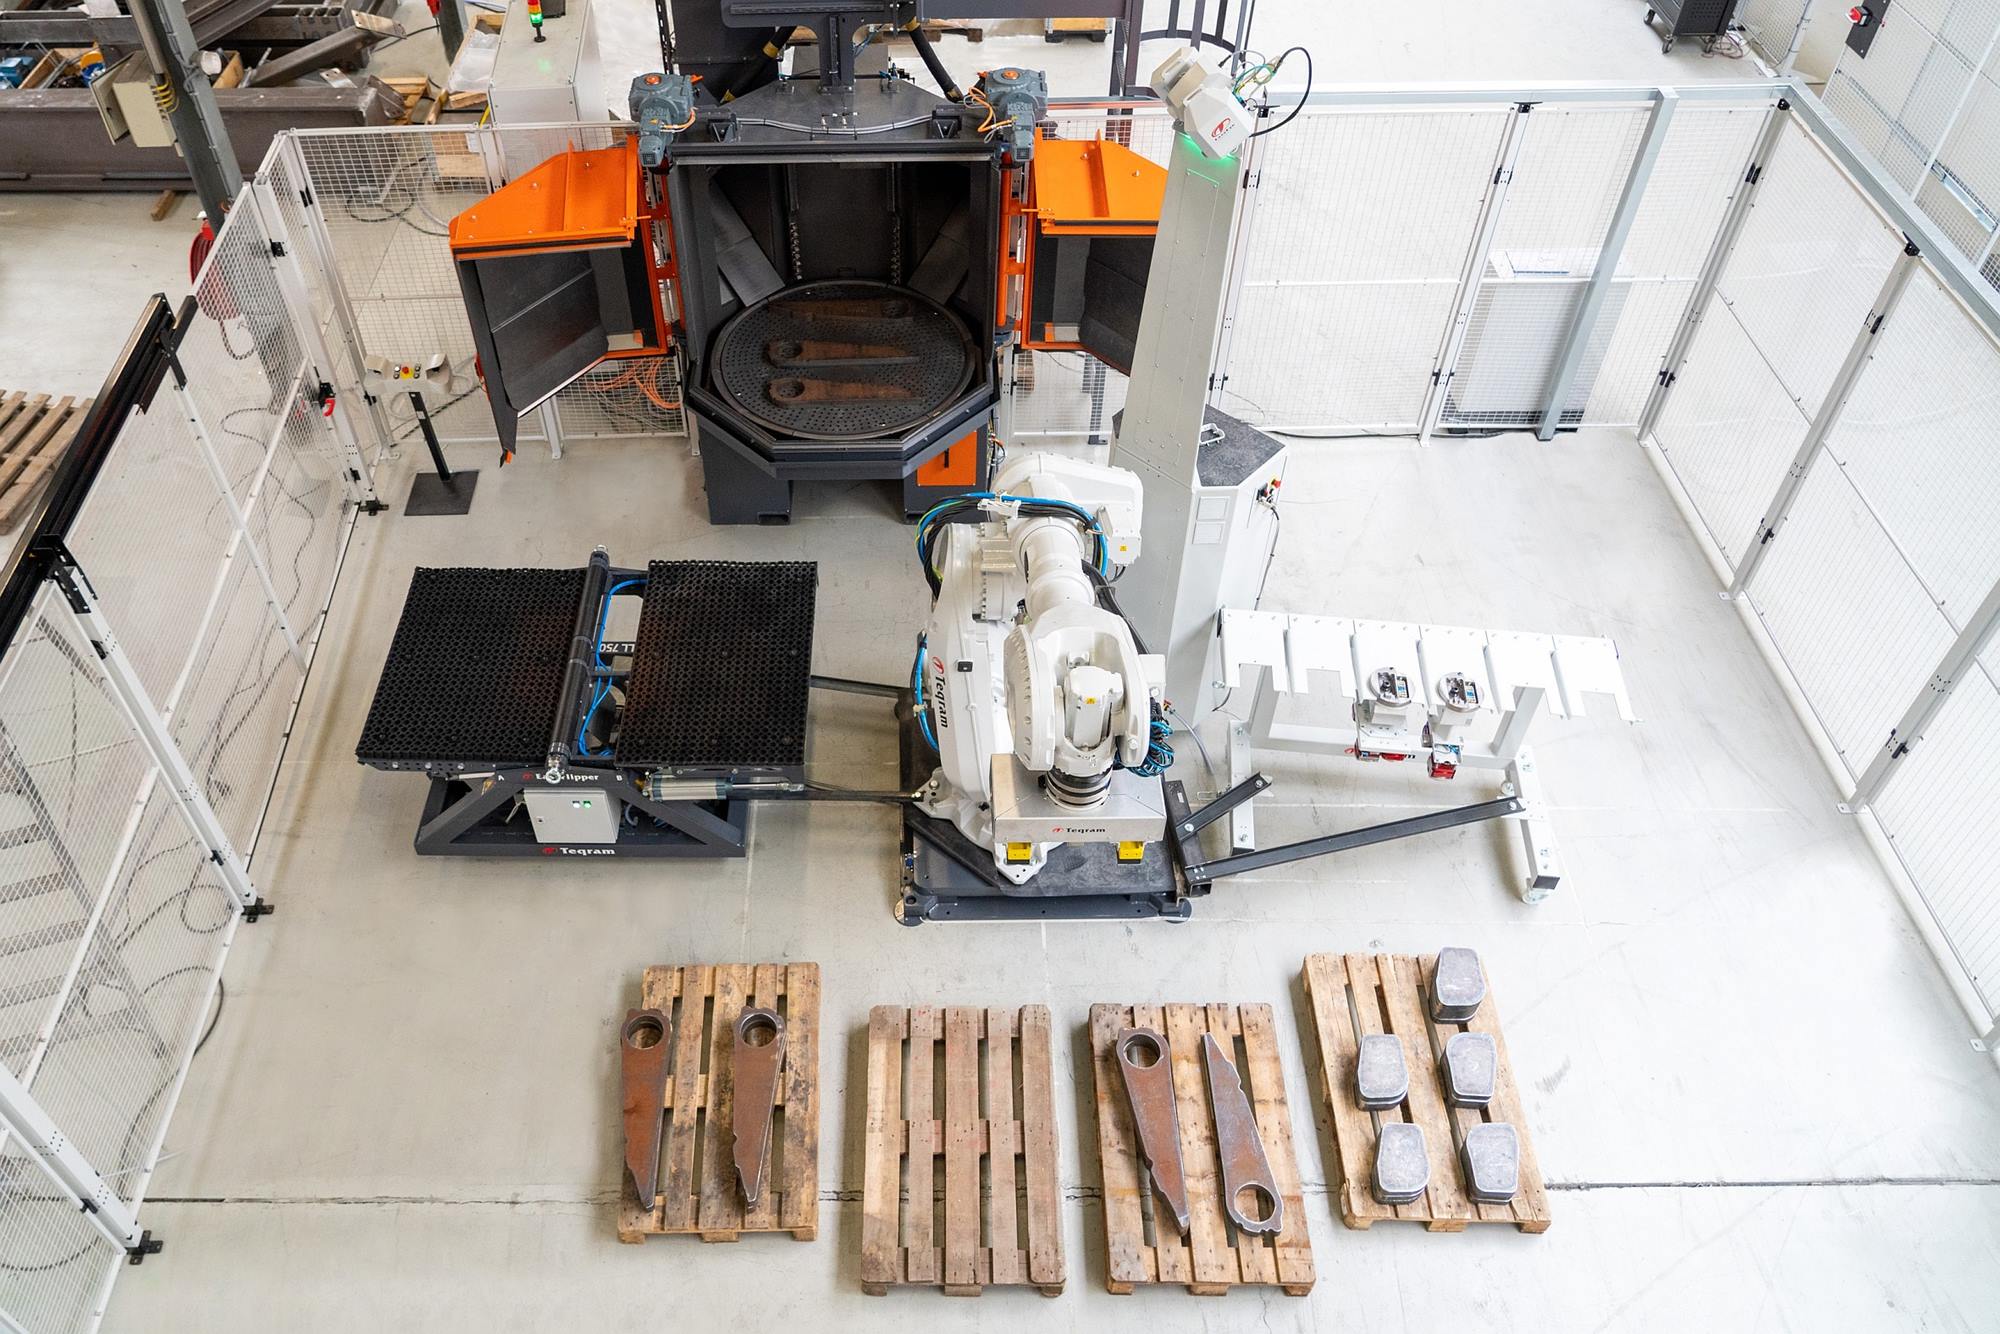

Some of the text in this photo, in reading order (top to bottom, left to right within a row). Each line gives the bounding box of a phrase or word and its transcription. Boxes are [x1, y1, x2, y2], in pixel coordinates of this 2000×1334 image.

[600, 643, 620, 653] 750
[935, 676, 949, 729] Teqram
[535, 773, 600, 783] Elipper
[616, 774, 623, 782] B
[559, 847, 616, 857] Teqram
